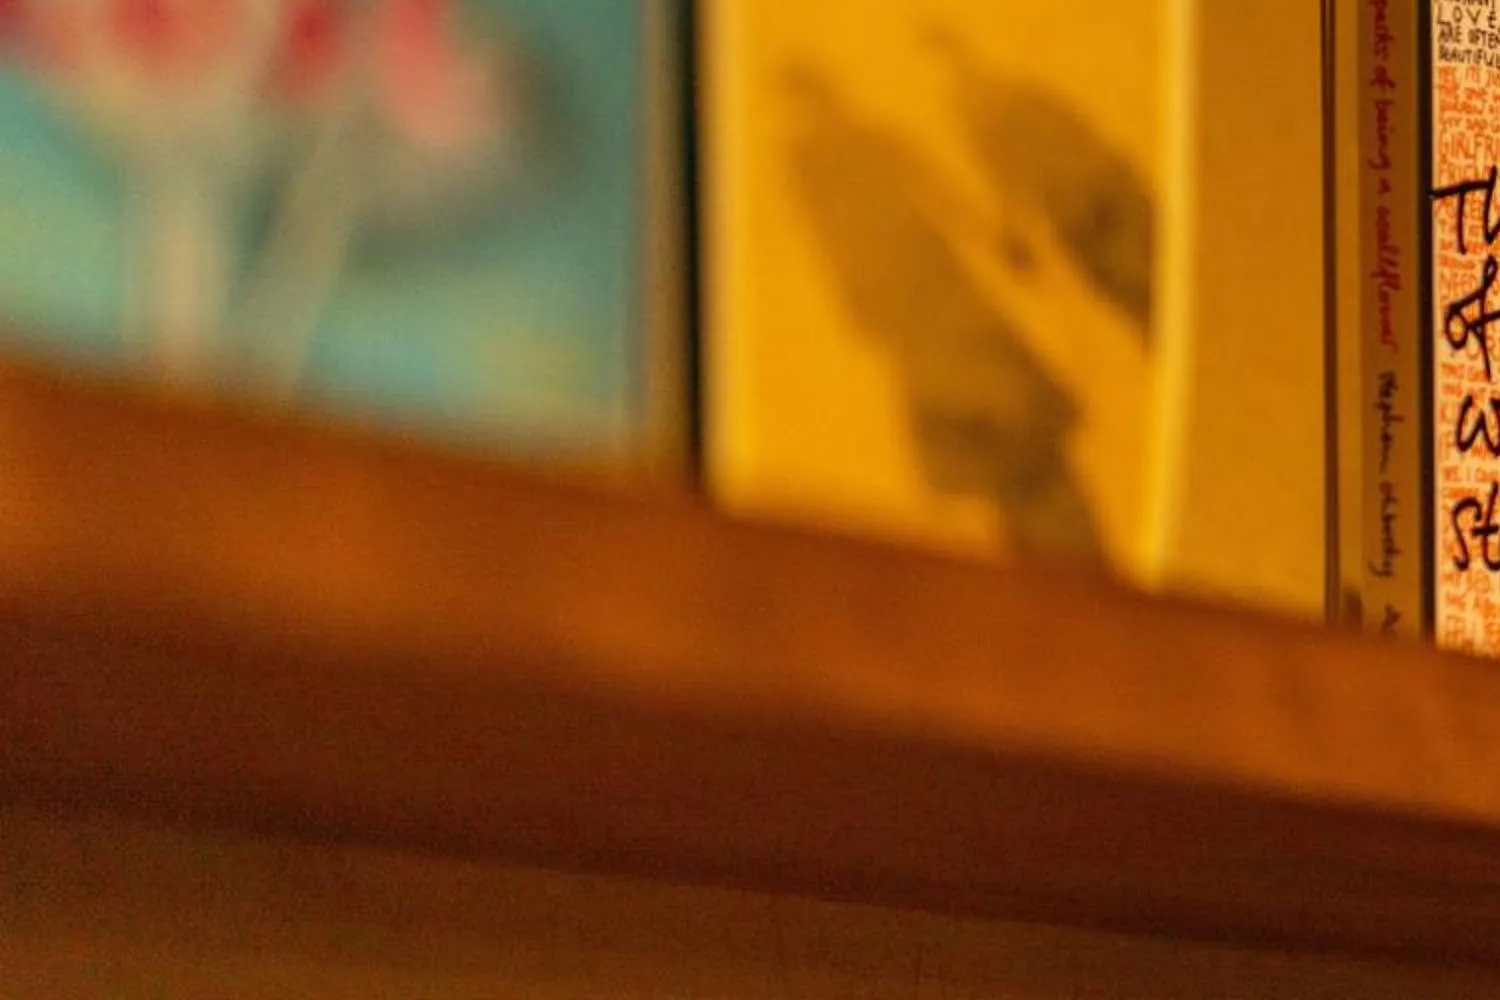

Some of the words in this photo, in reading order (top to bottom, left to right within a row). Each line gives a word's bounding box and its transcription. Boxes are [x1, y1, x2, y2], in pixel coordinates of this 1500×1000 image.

[1368, 65, 1397, 91] of
[1366, 99, 1397, 170] being
[1369, 205, 1402, 353] wallflower
